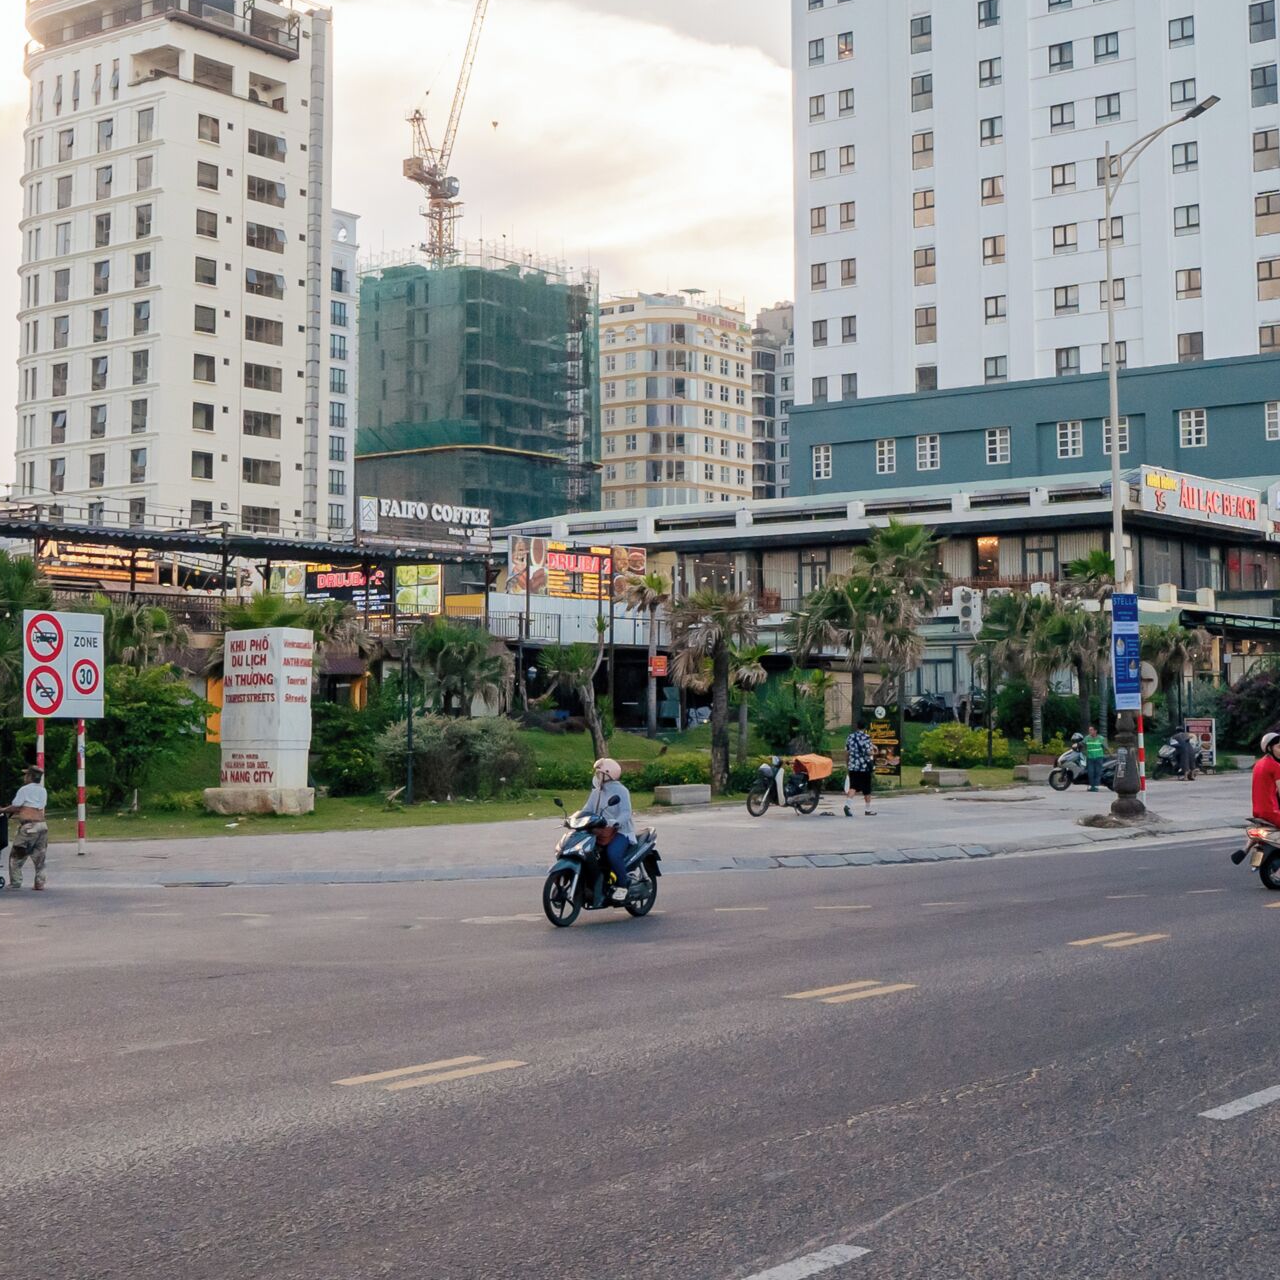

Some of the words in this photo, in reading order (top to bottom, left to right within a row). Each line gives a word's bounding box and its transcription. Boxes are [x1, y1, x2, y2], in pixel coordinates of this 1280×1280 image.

[379, 498, 428, 520] FAIFO
[431, 503, 490, 526] COFFEE
[1220, 493, 1258, 520] BEACH
[74, 636, 98, 648] ZONE
[230, 639, 246, 653] KHU
[249, 633, 270, 651] PHỐ
[231, 655, 243, 668] DU
[245, 654, 267, 670] LỊCH
[79, 668, 93, 685] 30
[224, 675, 233, 688] AN
[246, 692, 275, 703] STREETS
[230, 770, 251, 783] NANG
[253, 770, 274, 783] CITY
